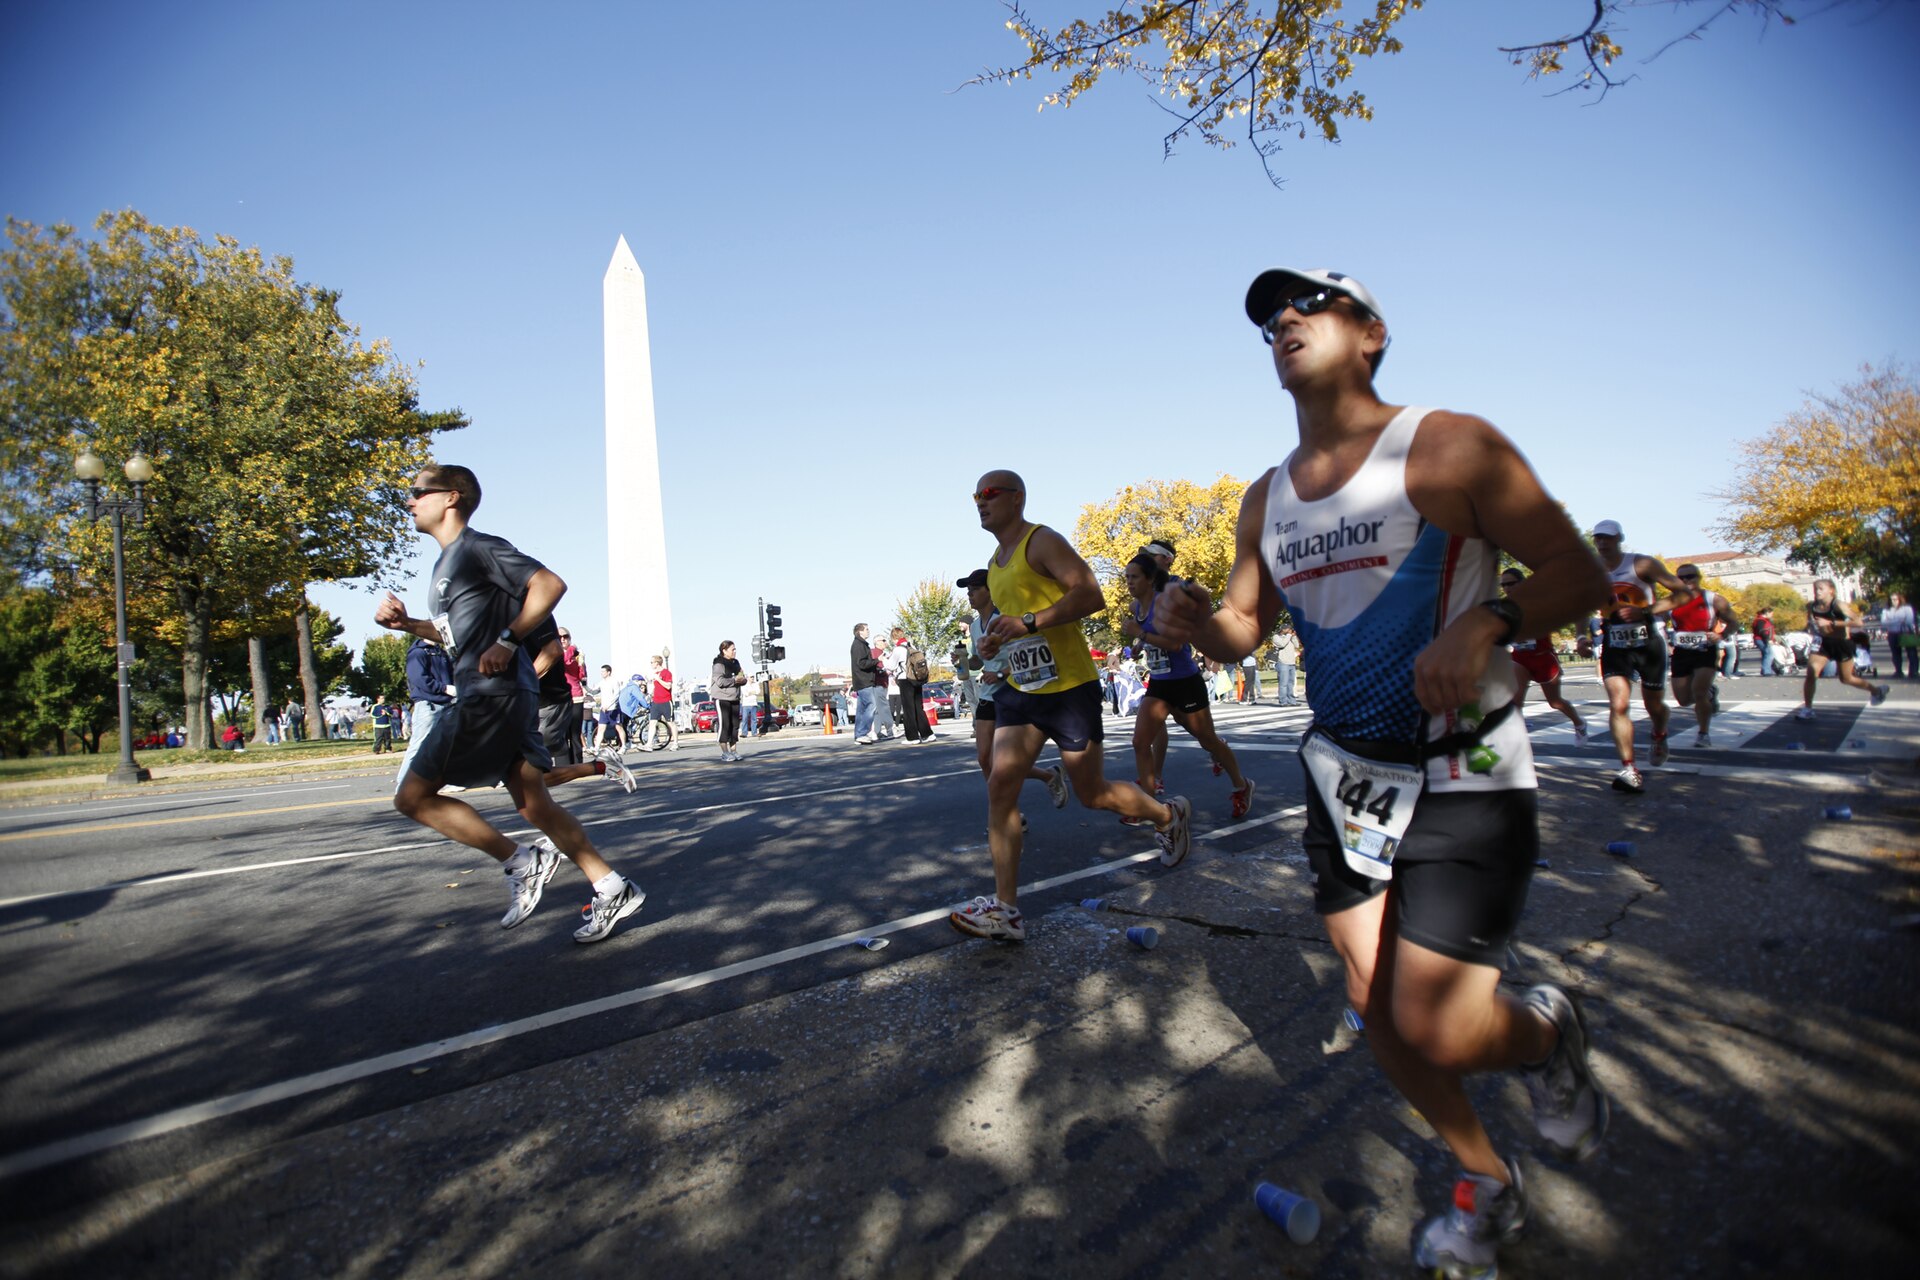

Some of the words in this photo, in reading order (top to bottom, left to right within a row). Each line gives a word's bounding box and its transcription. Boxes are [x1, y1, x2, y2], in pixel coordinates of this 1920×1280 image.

[1275, 520, 1298, 536] Team
[1276, 516, 1384, 571] Aquaphor
[1322, 557, 1380, 575] OINTMENT
[1611, 627, 1648, 641] 13164
[1009, 645, 1052, 671] 19970
